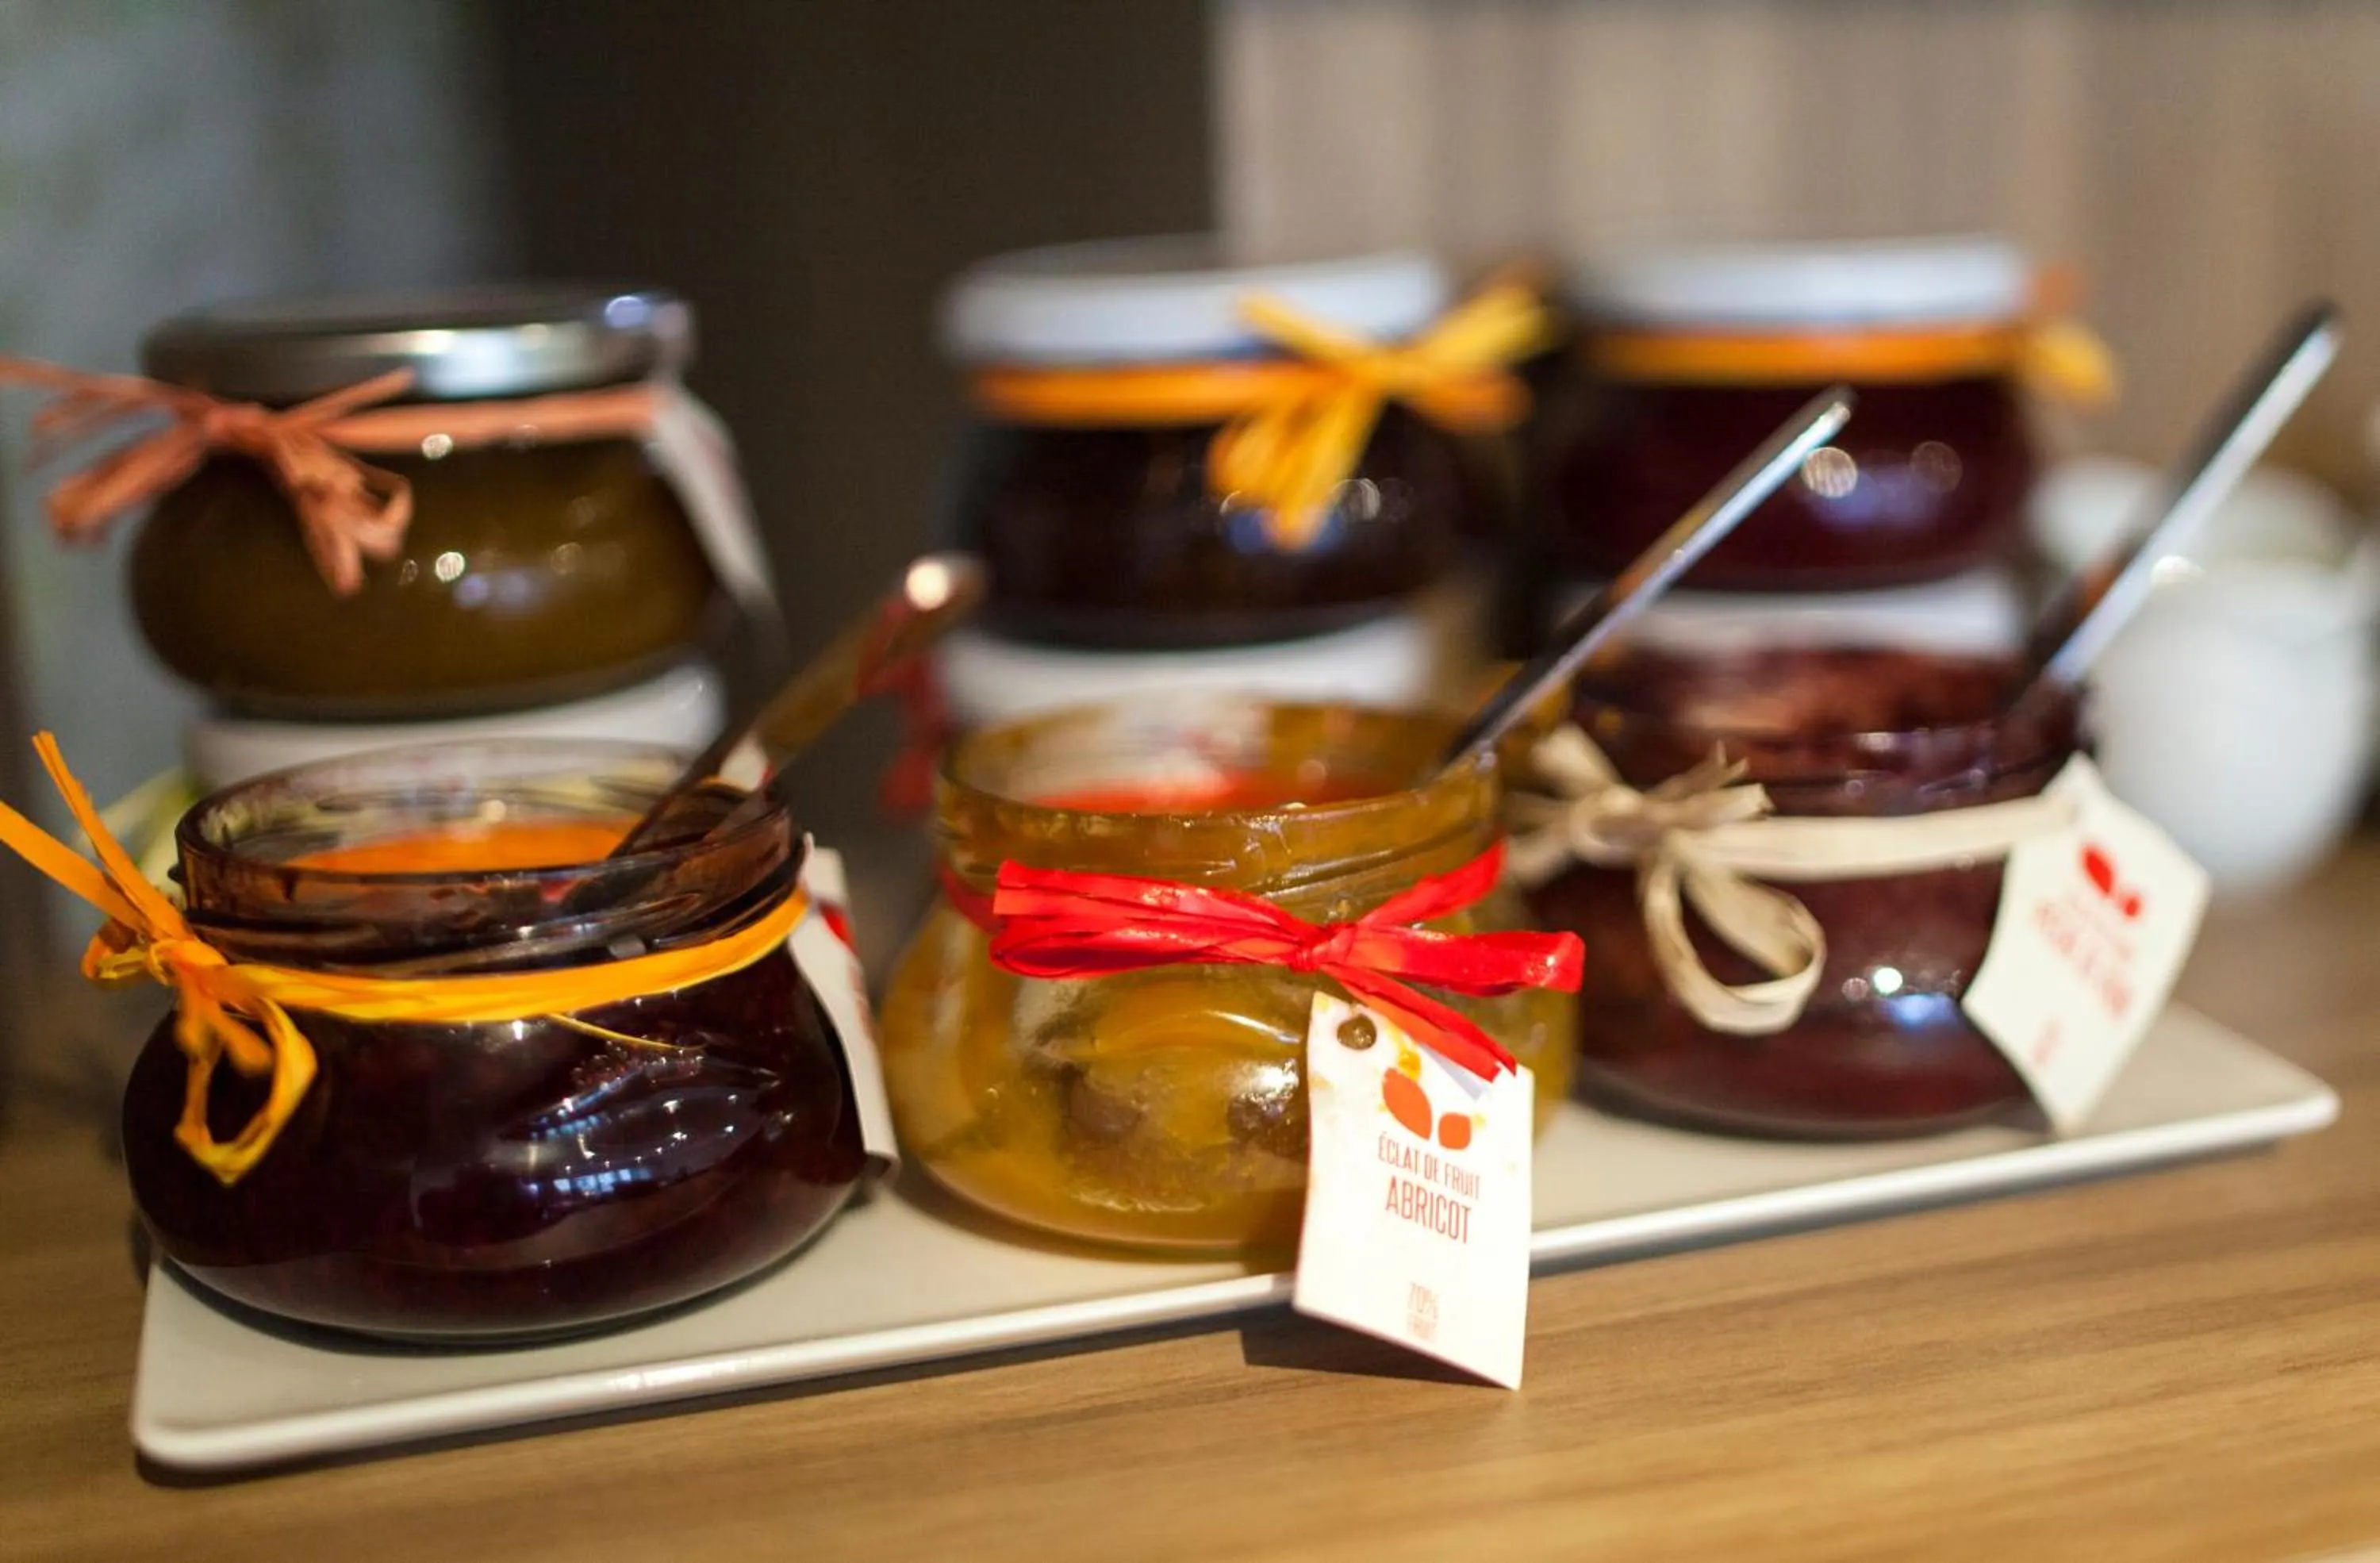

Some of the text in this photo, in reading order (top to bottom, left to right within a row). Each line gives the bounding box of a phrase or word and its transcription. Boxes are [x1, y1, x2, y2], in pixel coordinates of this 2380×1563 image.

[1378, 1131, 1480, 1200] ÉCLAT DE FRUIT
[1385, 1175, 1472, 1244] ABRICOT
